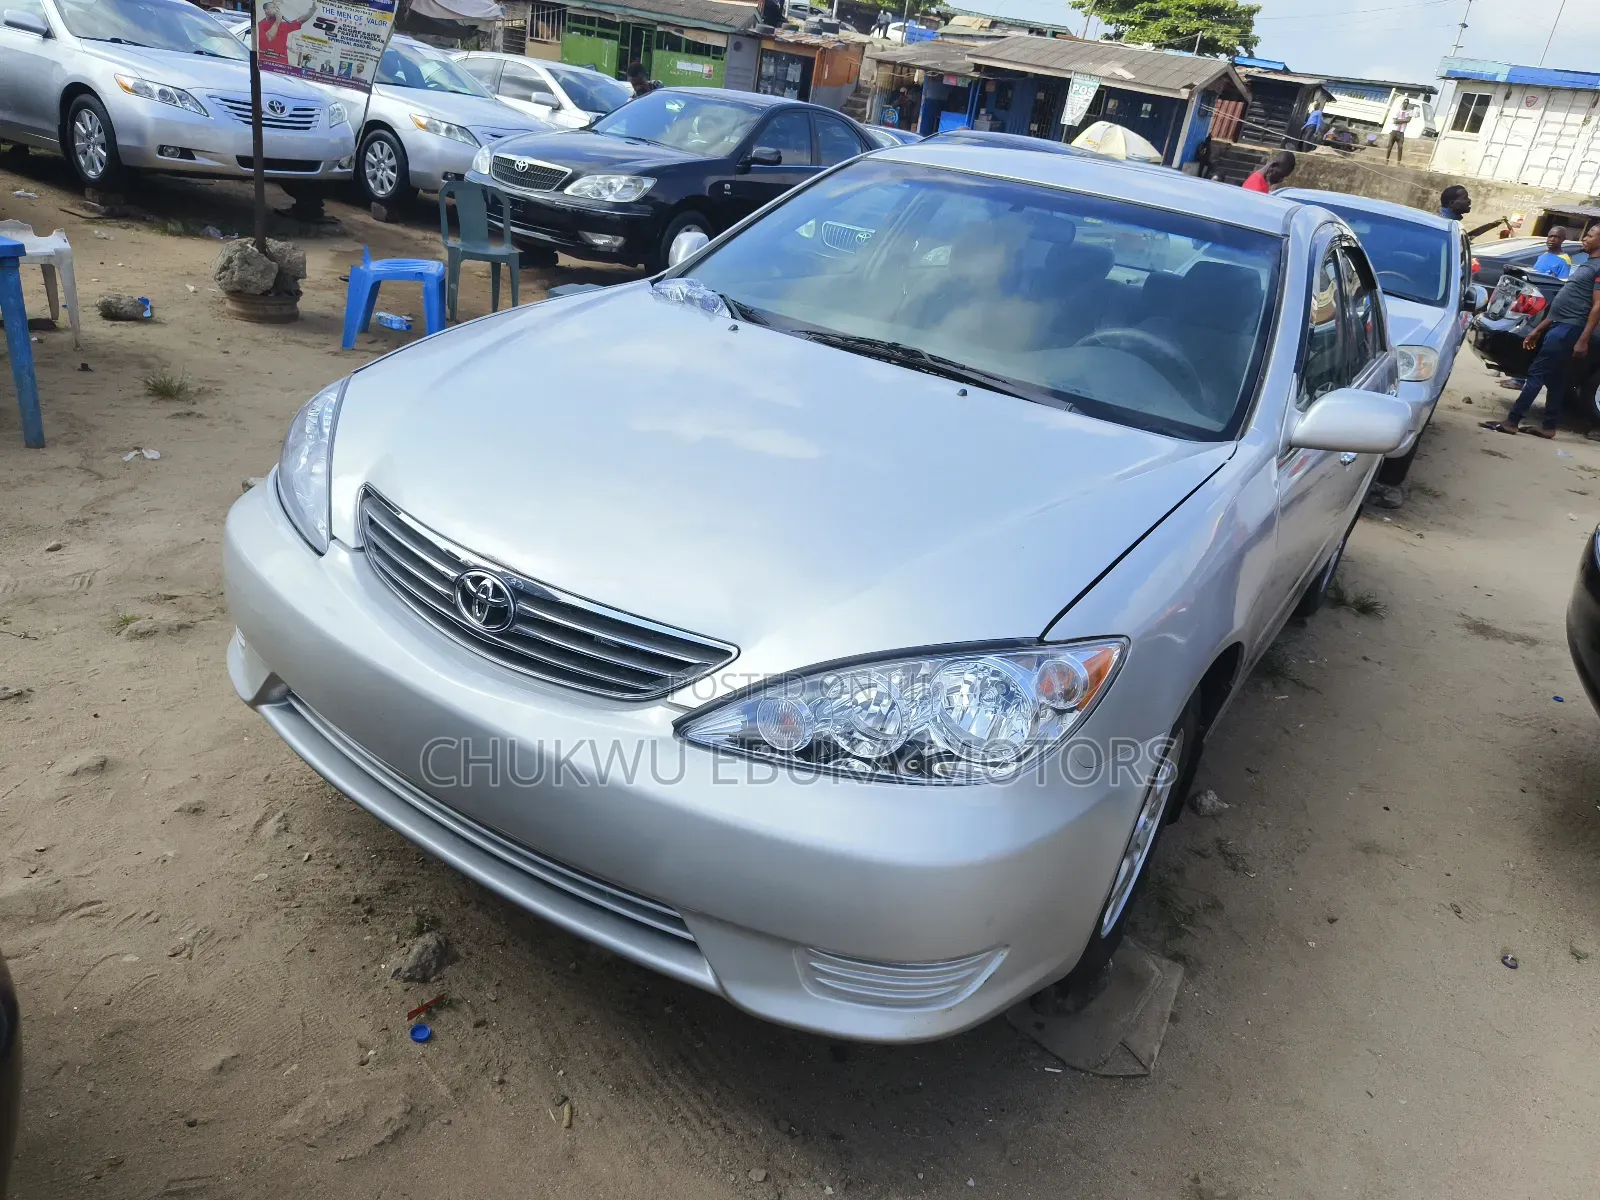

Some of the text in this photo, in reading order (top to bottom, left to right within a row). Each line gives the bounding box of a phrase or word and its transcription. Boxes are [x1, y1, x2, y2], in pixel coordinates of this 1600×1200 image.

[321, 6, 335, 16] THE
[336, 10, 352, 20] MEN
[353, 14, 364, 22] OF
[366, 17, 388, 28] VALOR
[1072, 83, 1096, 96] POS
[1513, 194, 1537, 203] FUEL
